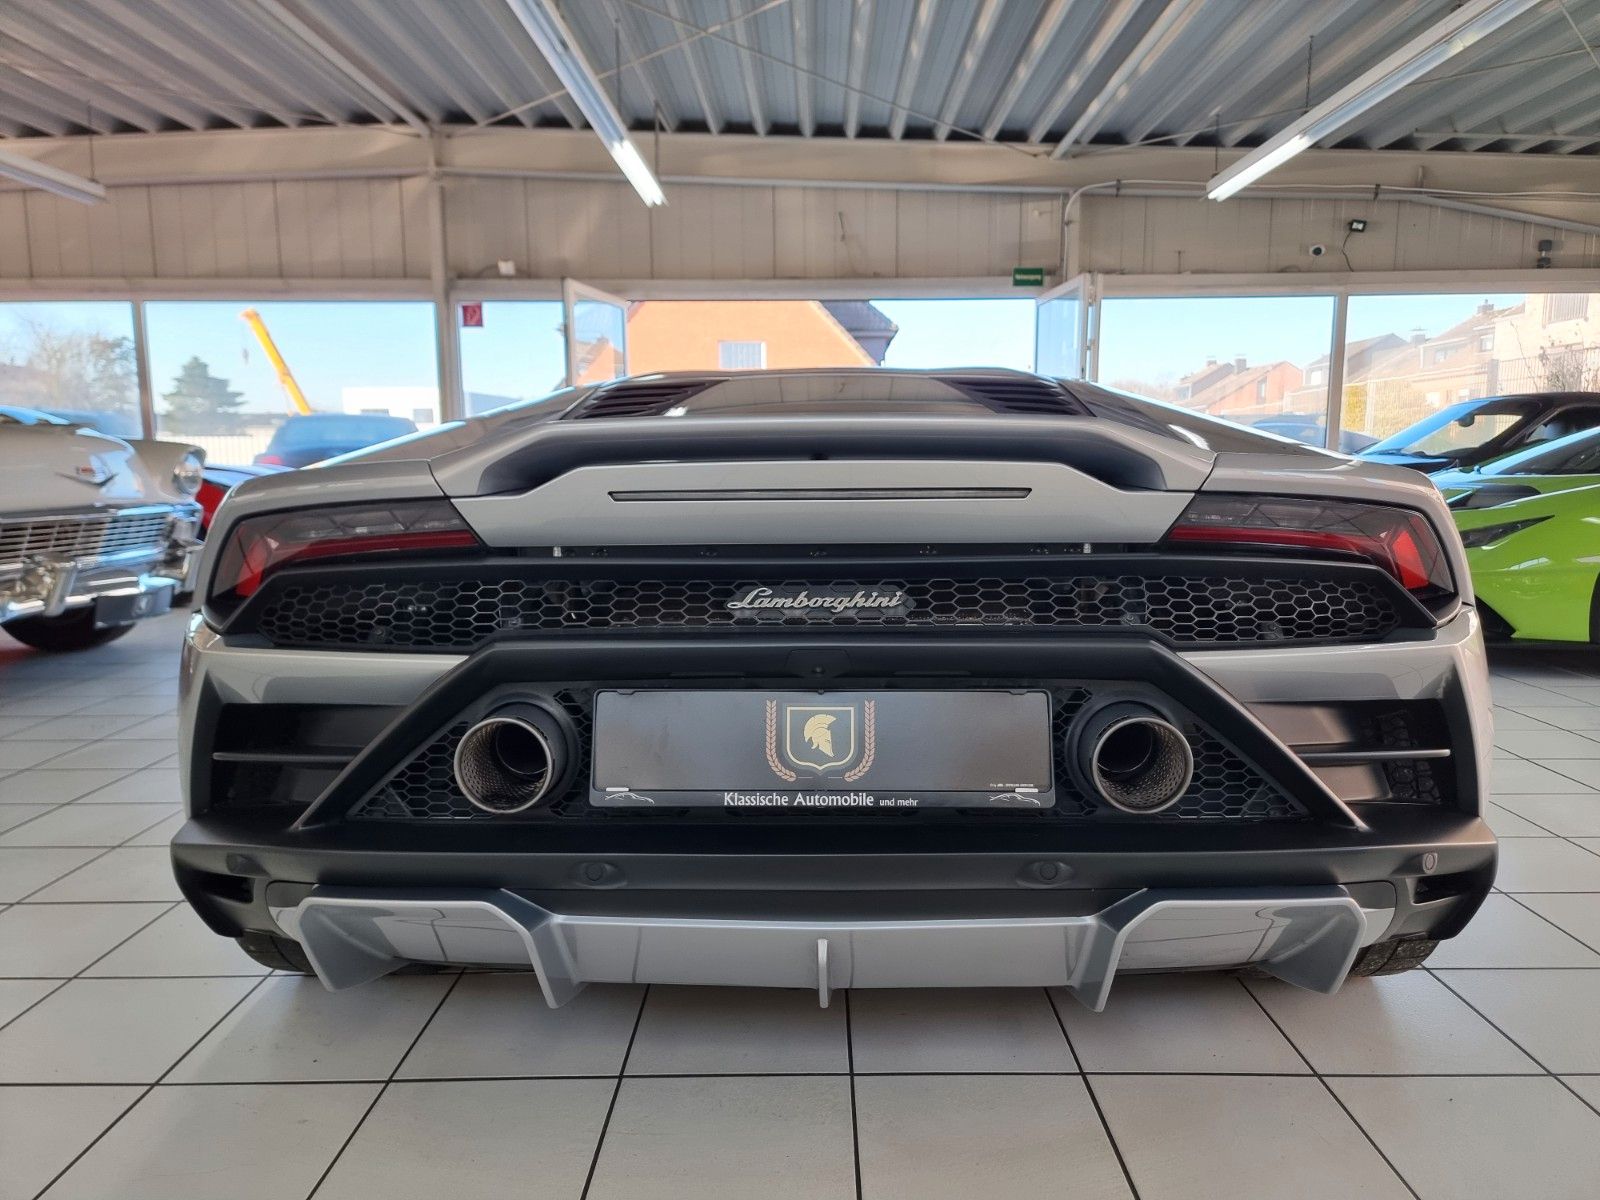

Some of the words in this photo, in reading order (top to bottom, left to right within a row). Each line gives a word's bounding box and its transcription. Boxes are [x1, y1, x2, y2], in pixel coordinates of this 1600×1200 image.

[727, 587, 903, 613] Lamborghini
[723, 792, 789, 806] Klassische
[793, 792, 874, 806] Automobile
[879, 798, 895, 807] und
[897, 799, 919, 807] mehr
